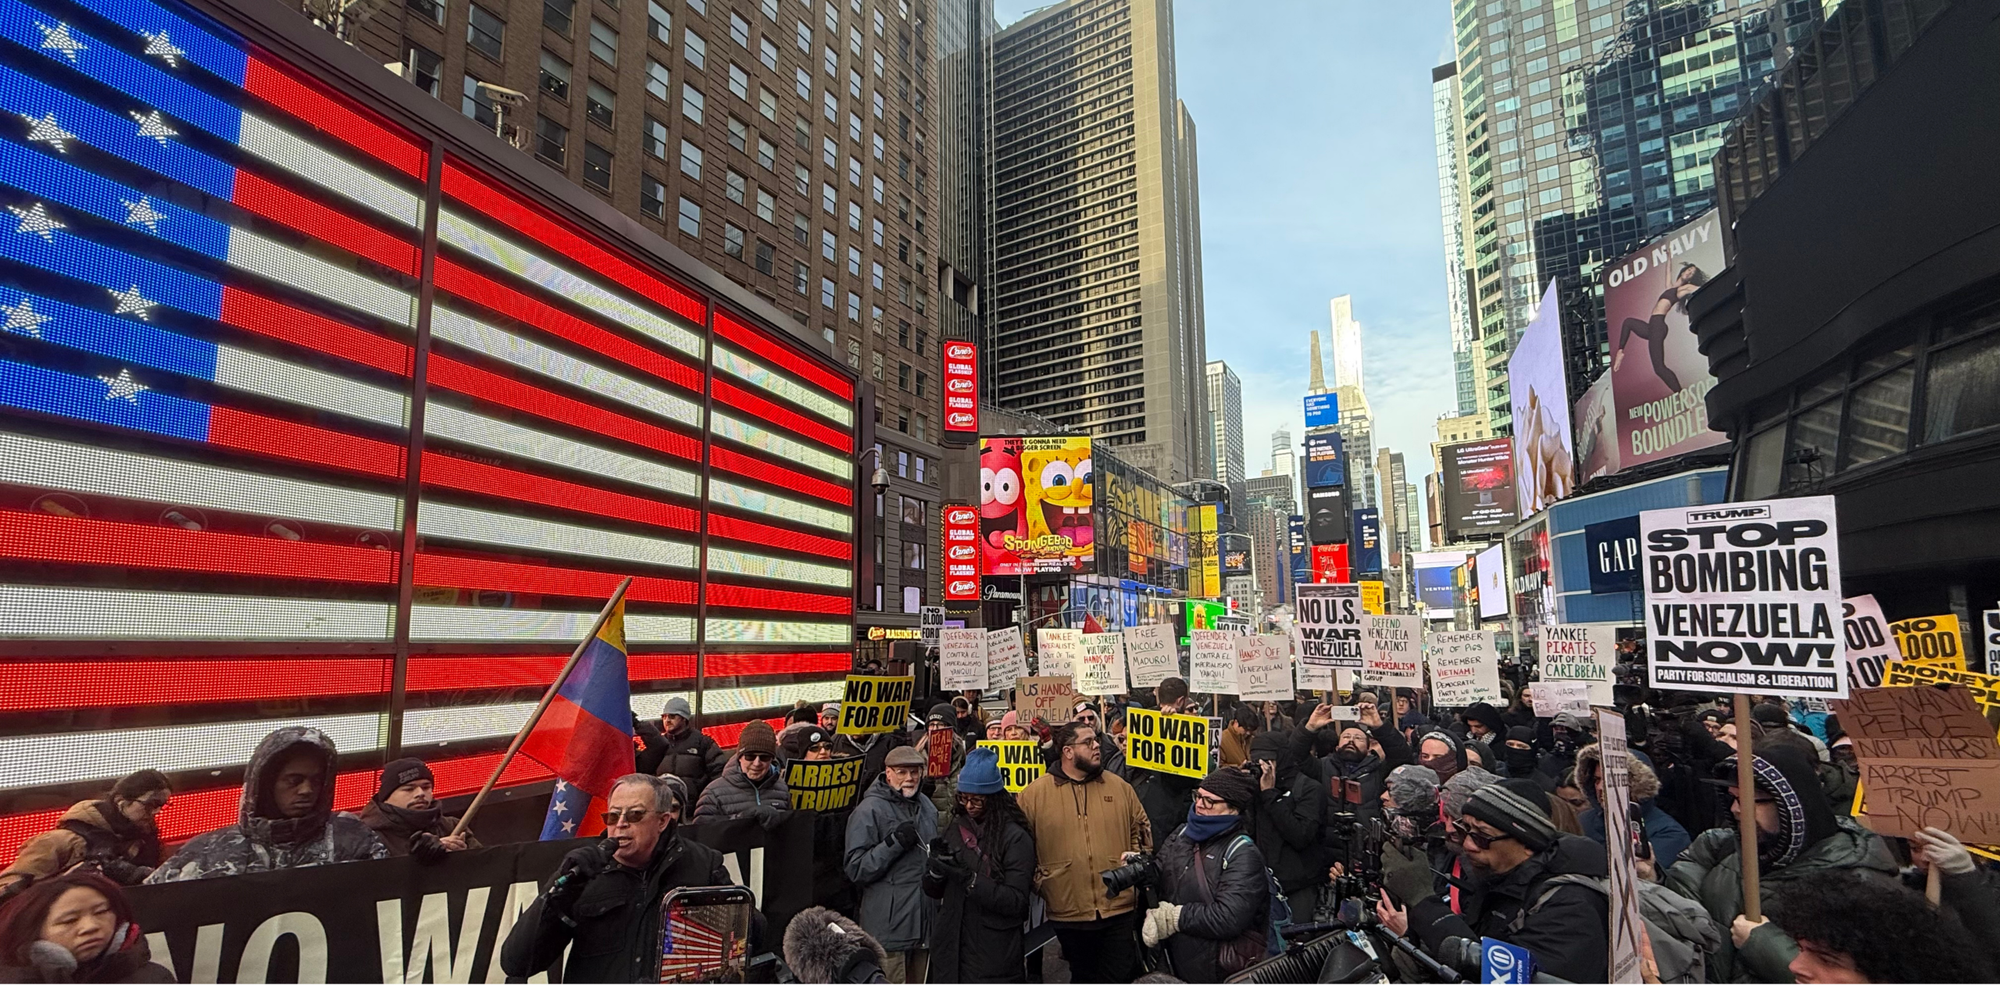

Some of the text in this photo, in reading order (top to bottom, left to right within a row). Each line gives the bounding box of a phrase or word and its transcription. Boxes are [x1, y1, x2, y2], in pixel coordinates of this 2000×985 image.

[1608, 221, 1713, 288] OLD NAVY
[949, 396, 973, 404] GLOBAL
[1629, 378, 1718, 423] NEW POWERSOF
[1631, 406, 1707, 455] BOUNDLE
[948, 510, 975, 525] Cane's
[1689, 508, 1768, 520] TRUMP:
[1004, 534, 1073, 551] SPONGEBOB
[1648, 520, 1828, 552] STOP
[948, 546, 975, 560] Cane's
[1598, 538, 1638, 574] GAP
[1650, 547, 1830, 594] BOMBING
[949, 581, 976, 595] Cane's
[1514, 571, 1542, 594] OLD NAVY
[983, 584, 1022, 600] Paramoun
[1300, 599, 1320, 623] NO
[1325, 599, 1360, 624] U.S.
[923, 614, 943, 625] BLOOD
[1372, 618, 1400, 628] DEFEND
[1652, 603, 1834, 639] VENEZUELA
[923, 628, 935, 638] FOR
[1135, 628, 1158, 638] FREE
[1301, 628, 1362, 640] WAR
[1368, 628, 1409, 640] VENEZUELA
[1546, 627, 1588, 641] YANKEE
[1890, 619, 1937, 635] NO
[886, 630, 912, 639] RAISING
[980, 631, 985, 640] A
[1045, 632, 1072, 640] YANKEE
[1078, 635, 1119, 645] WALL STREET
[1437, 633, 1483, 644] REMEMBER
[943, 642, 978, 650] VENEZUELA
[1086, 645, 1115, 654] VULTURES
[1196, 642, 1233, 650] VENEZUELA
[1265, 647, 1280, 657] OFF
[1301, 641, 1363, 658] VENEZUELA
[1374, 641, 1408, 651] AGAINST
[1431, 646, 1443, 655] BAY
[1465, 644, 1482, 652] PIGS
[1546, 641, 1596, 654] PIRATES
[1896, 632, 1956, 661] LOOD
[1084, 655, 1114, 664] HANDS OFF
[1133, 654, 1170, 666] MADURO!
[1438, 656, 1481, 666] REMEMBER
[1546, 655, 1563, 663] OUT
[1579, 656, 1594, 664] THE
[1654, 640, 1836, 668] NOW!
[1043, 661, 1059, 669] GULF
[1239, 664, 1283, 674] VENEZUELAN
[1368, 660, 1415, 671] IMPERIALISM
[1437, 667, 1474, 677] VIETNAM!
[1546, 664, 1606, 678] CARIBBEAN
[1085, 671, 1110, 679] AMERICA
[1250, 674, 1268, 684] OIL!
[1658, 669, 1833, 689] PARTY FOR SOCIALISM & LIBERATION
[1892, 662, 2000, 688] MONEY
[1041, 683, 1071, 696] HANDS
[1436, 679, 1475, 689] DEMOCRATIC
[845, 680, 912, 703] NO WAR
[1534, 688, 1575, 698] NO WAR
[1035, 696, 1055, 708] OFF
[1840, 686, 1972, 712] WE WANT
[1535, 703, 1549, 712] FOR
[843, 704, 907, 728] FOR OIL
[1017, 708, 1071, 722] VENEZUELA
[1130, 713, 1206, 745] NO WAR
[1851, 714, 1989, 738] PEACE
[1004, 745, 1044, 764] WAR
[1132, 738, 1166, 764] FOR
[1171, 745, 1202, 771] OIL
[1858, 739, 1909, 758] NOT
[787, 759, 863, 787] ARREST
[930, 761, 942, 776] OIL
[1868, 765, 1970, 786] ARREST
[789, 783, 856, 812] TRUMP
[1873, 787, 1981, 810] TRUMP
